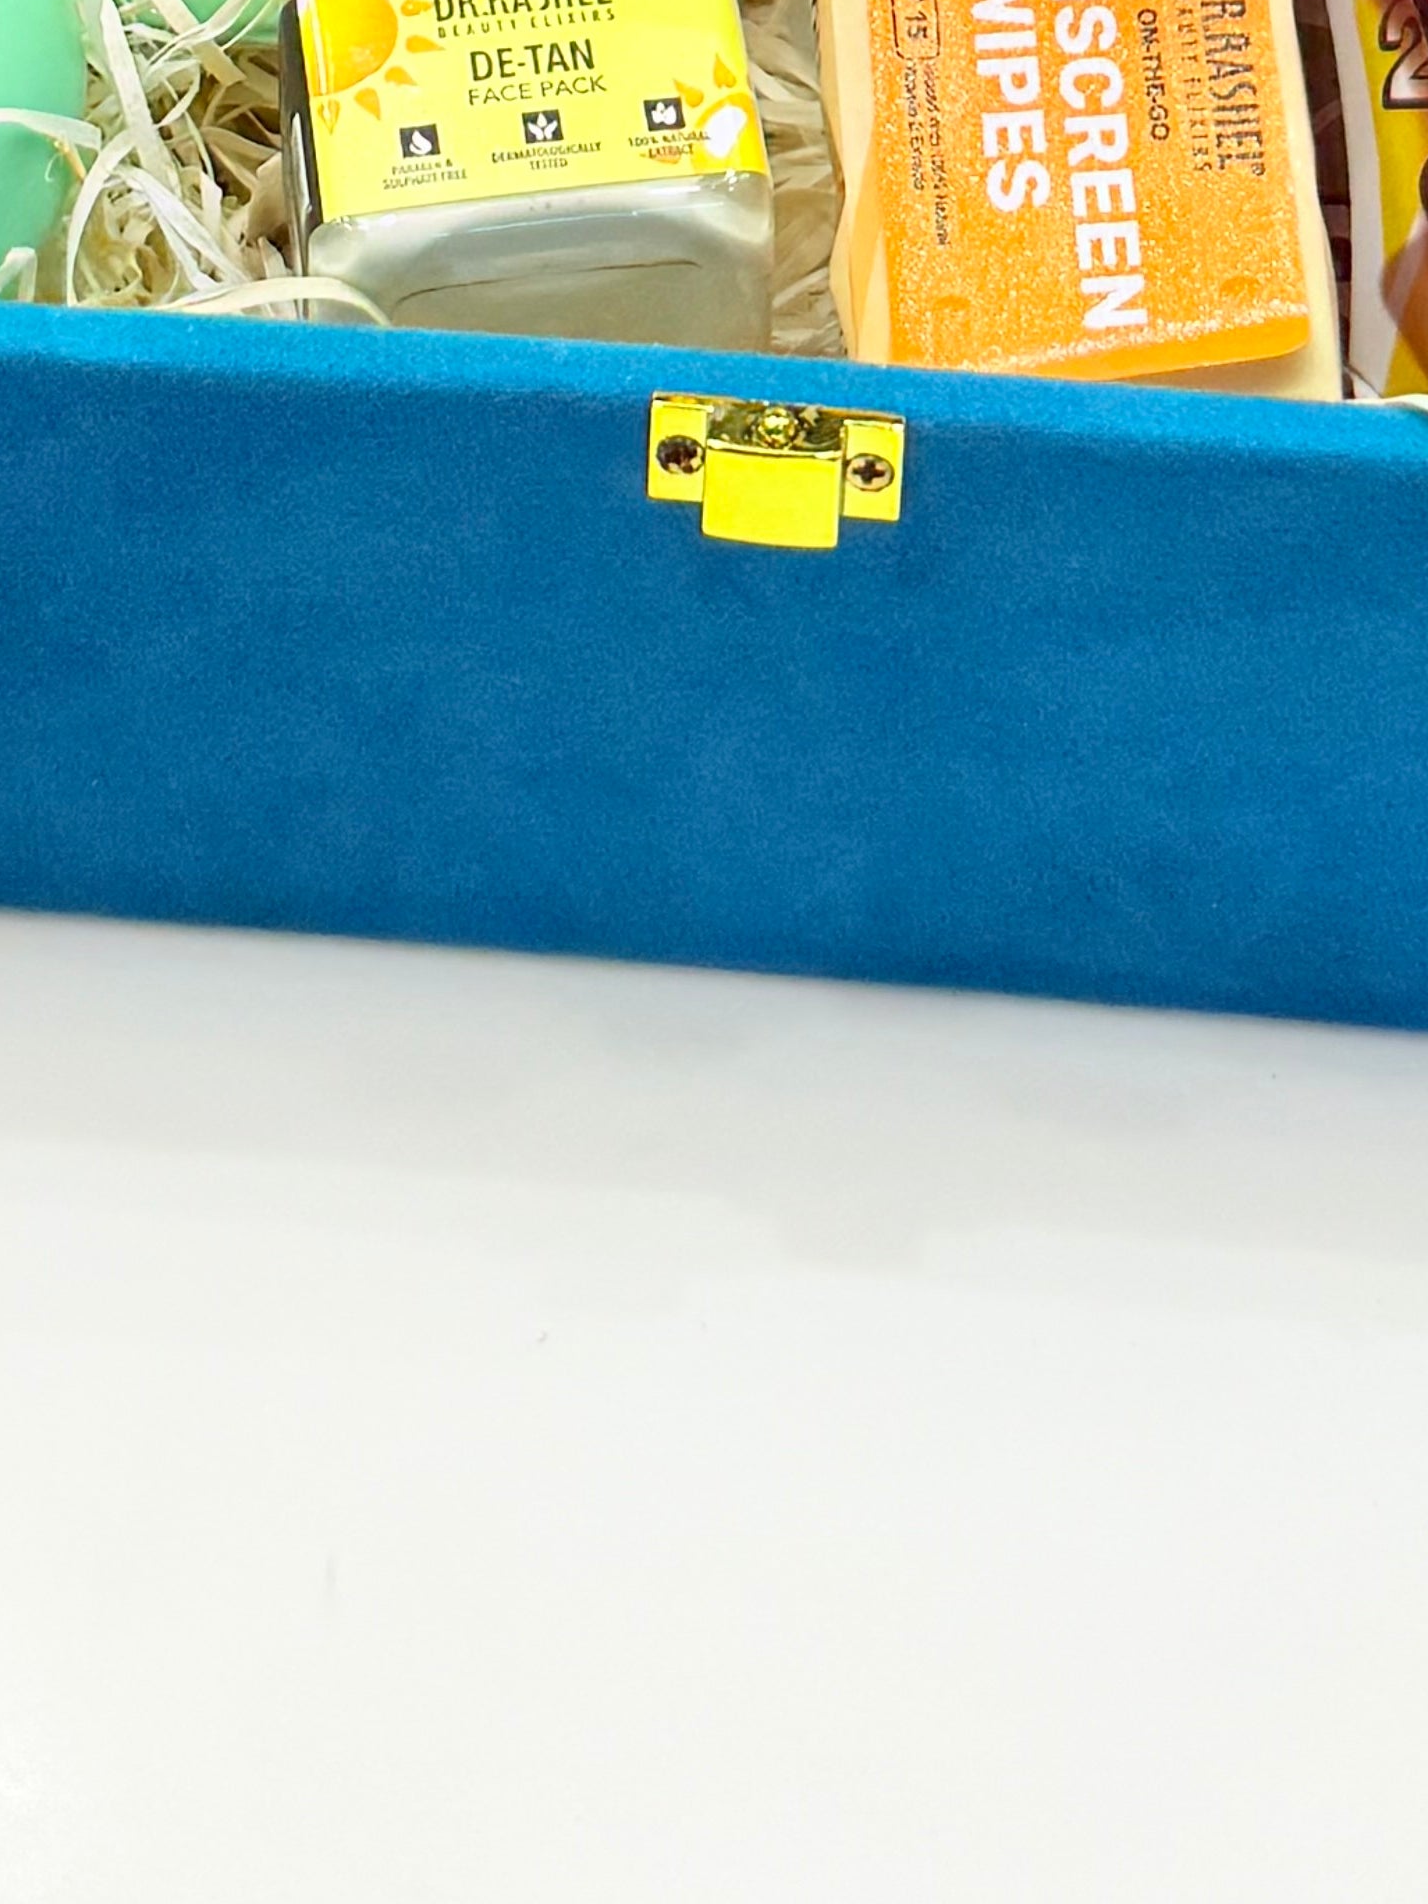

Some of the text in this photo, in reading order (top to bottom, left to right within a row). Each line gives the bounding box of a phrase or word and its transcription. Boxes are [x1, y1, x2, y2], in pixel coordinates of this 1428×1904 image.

[438, 8, 615, 39] BEAUTY ELIXIRS
[910, 10, 933, 42] 15
[469, 39, 595, 82] DE-TAN
[1137, 8, 1170, 142] ON-THE-GO
[468, 75, 607, 106] FACE PACK
